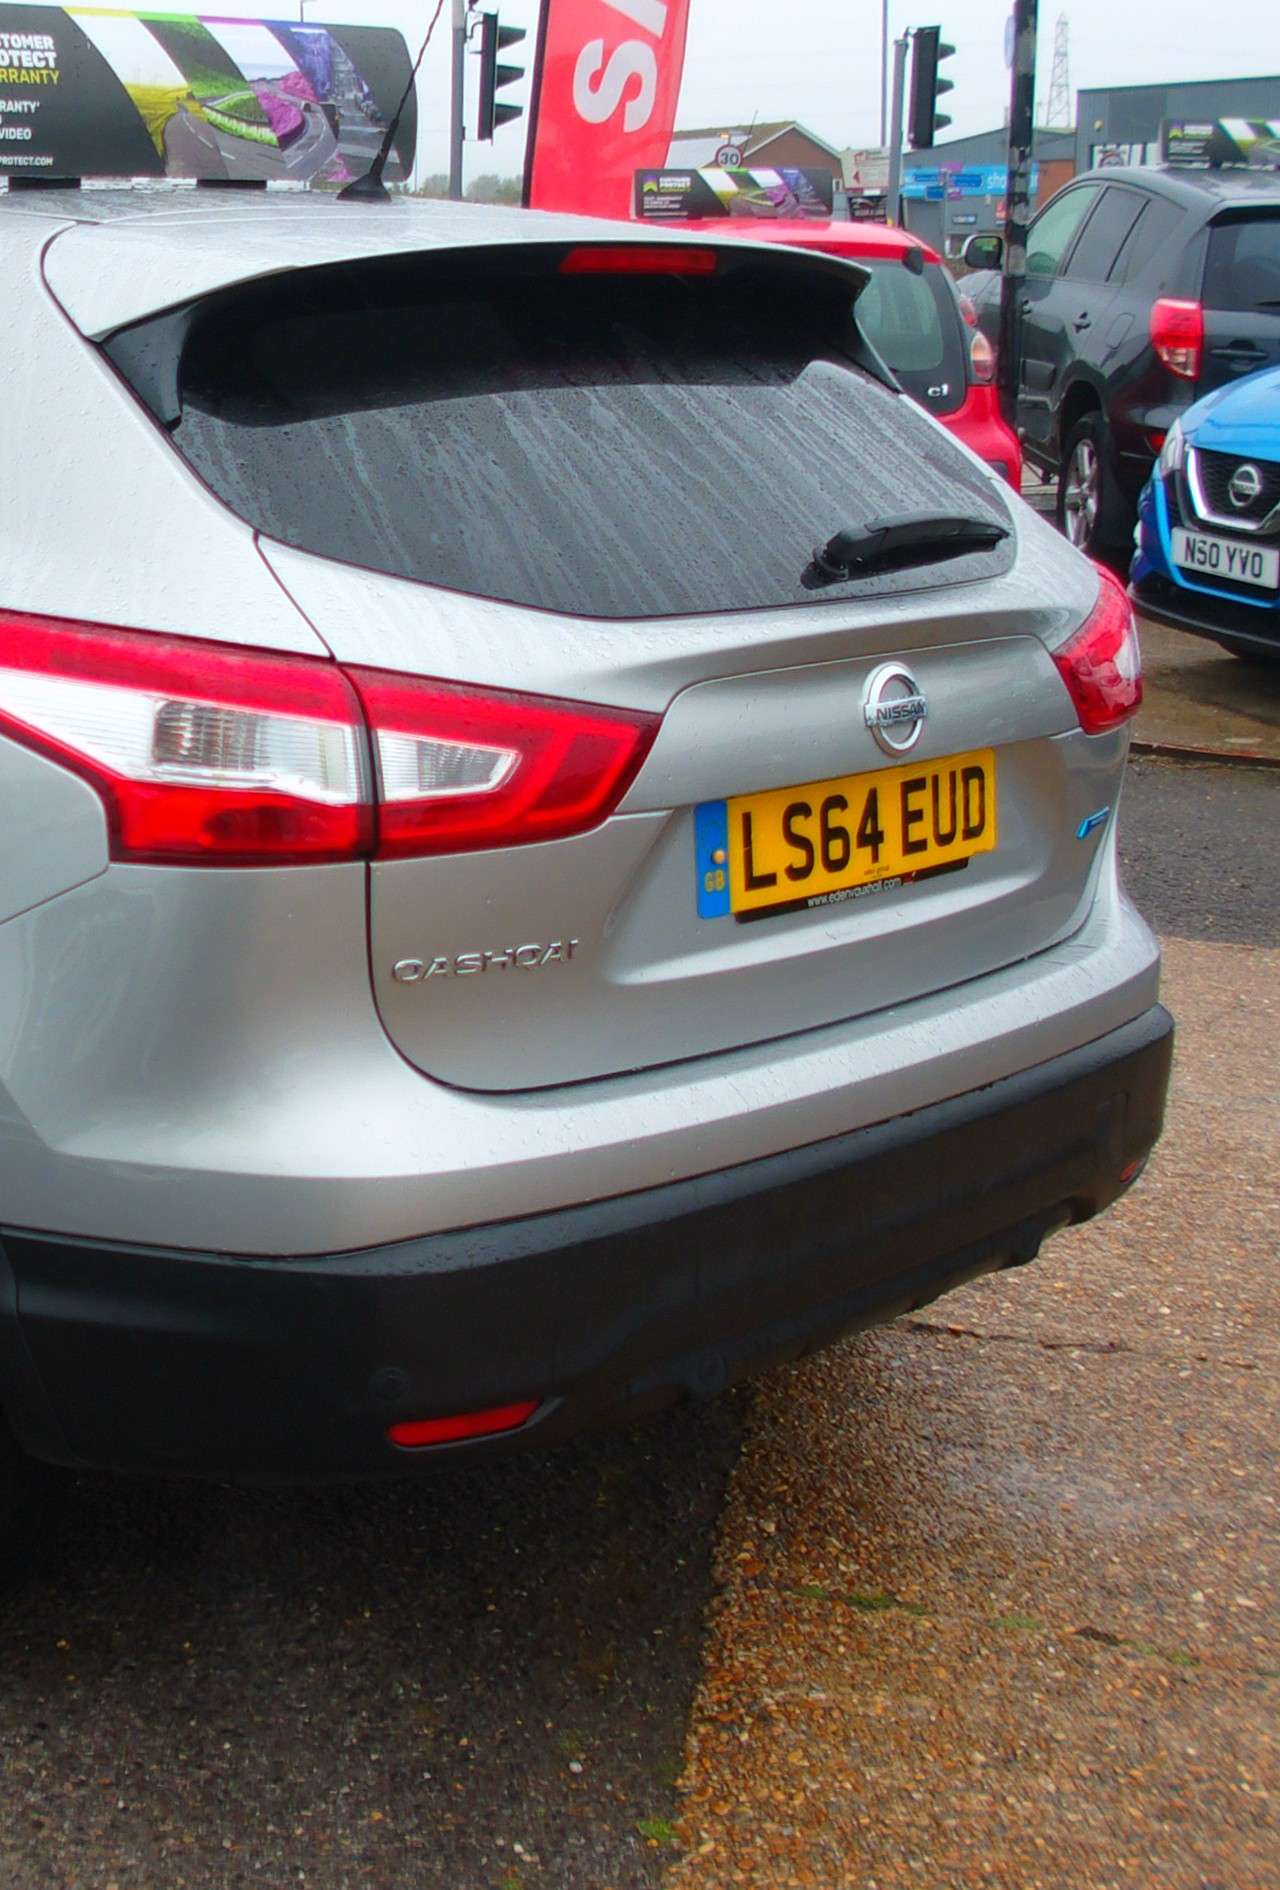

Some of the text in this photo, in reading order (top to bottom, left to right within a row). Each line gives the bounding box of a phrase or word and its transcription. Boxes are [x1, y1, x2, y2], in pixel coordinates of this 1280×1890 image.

[720, 152, 740, 166] 30
[876, 702, 927, 721] NISSAN
[740, 764, 986, 892] LS64 EUD
[704, 869, 726, 892] GB
